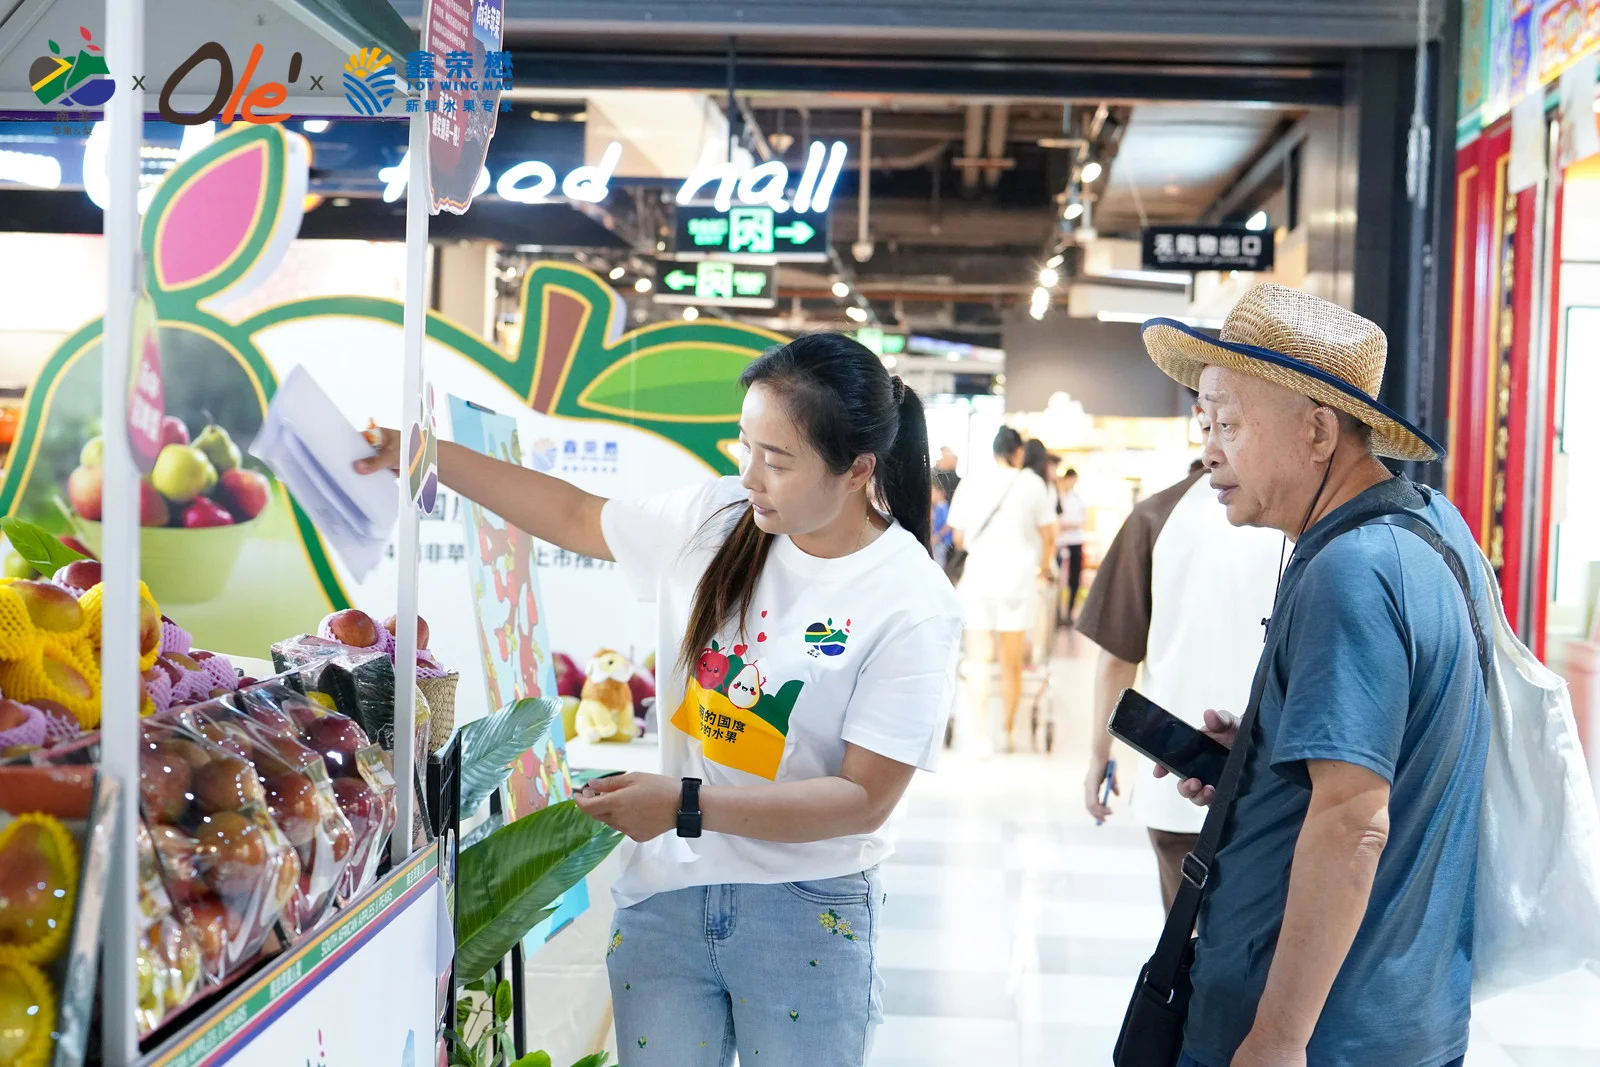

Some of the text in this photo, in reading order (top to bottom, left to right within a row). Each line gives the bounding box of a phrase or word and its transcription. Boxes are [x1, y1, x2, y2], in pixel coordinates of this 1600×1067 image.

[675, 140, 848, 213] hall
[358, 902, 376, 926] APPLES
[379, 887, 393, 910] PEARS
